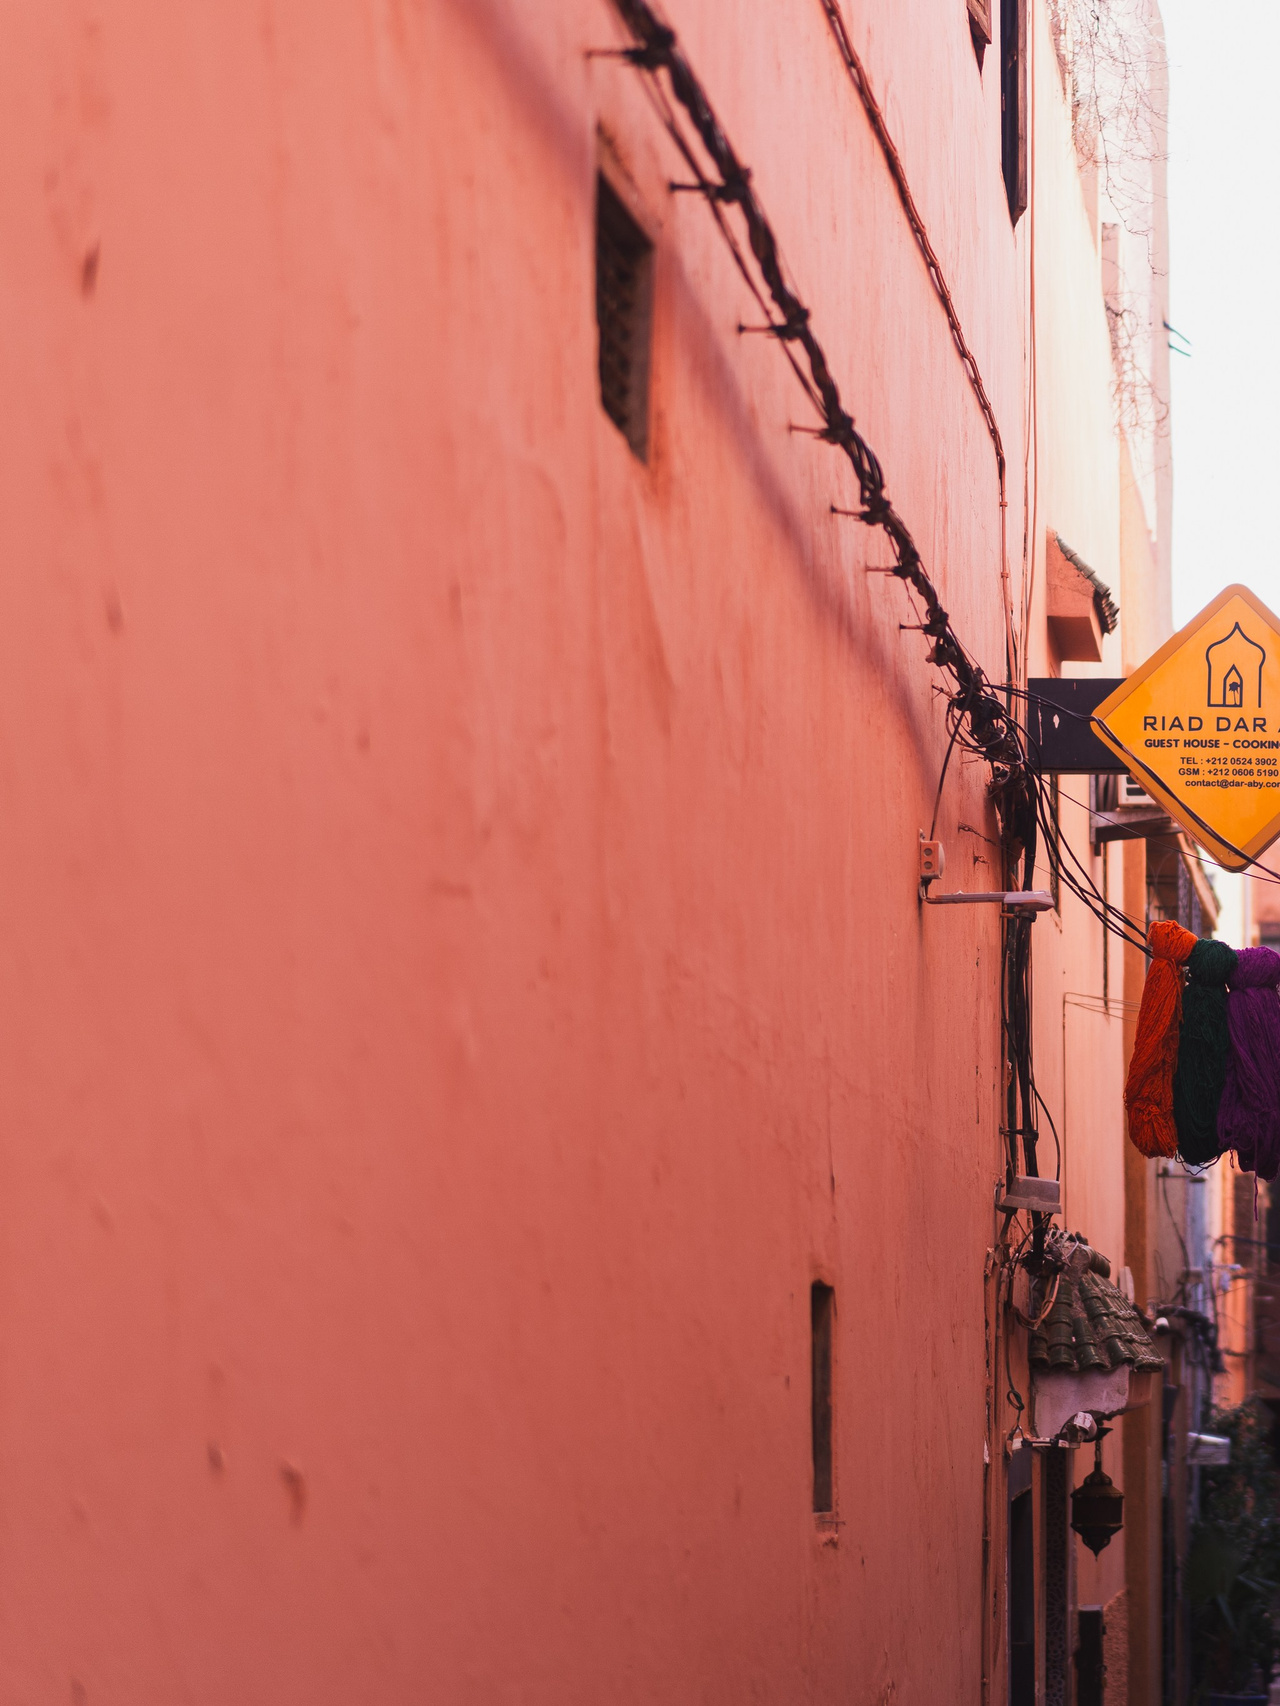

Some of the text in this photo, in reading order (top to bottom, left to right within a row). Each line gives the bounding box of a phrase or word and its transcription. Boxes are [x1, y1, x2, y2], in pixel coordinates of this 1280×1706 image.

[1143, 716, 1203, 732] RIAD
[1216, 717, 1267, 733] DAR
[1144, 739, 1180, 748] GUEST
[1183, 739, 1220, 748] HOUSE
[1180, 757, 1198, 765] TEL
[1206, 757, 1228, 765] +212
[1255, 758, 1278, 766] 3902
[1178, 768, 1200, 776] GSM
[1208, 768, 1230, 776] +212
[1257, 769, 1279, 777] 5190
